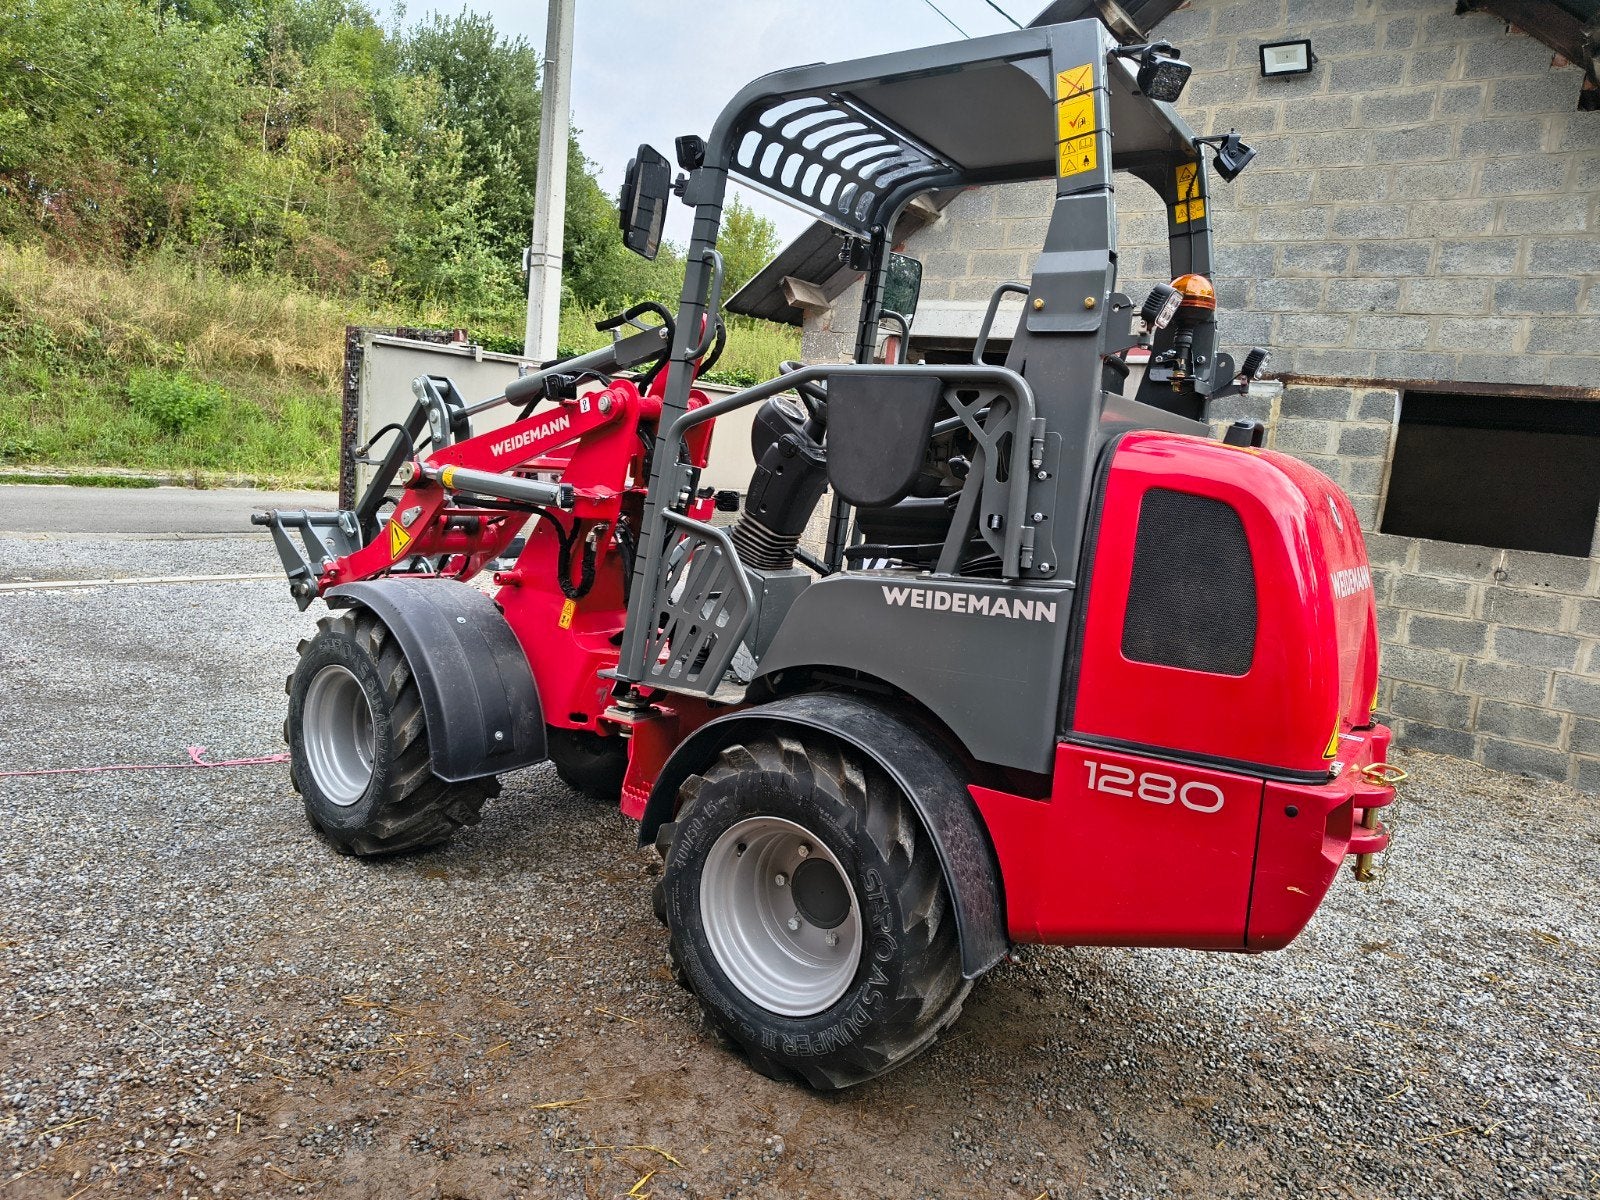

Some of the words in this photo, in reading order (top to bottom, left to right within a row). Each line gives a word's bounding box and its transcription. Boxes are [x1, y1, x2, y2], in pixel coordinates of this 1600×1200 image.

[490, 414, 570, 457] WEIDEMANN
[881, 585, 1057, 623] WEIDEMANN
[1330, 565, 1371, 600] WEIDEMANN
[1083, 760, 1225, 813] 1280
[783, 1002, 873, 1057] DUMPER
